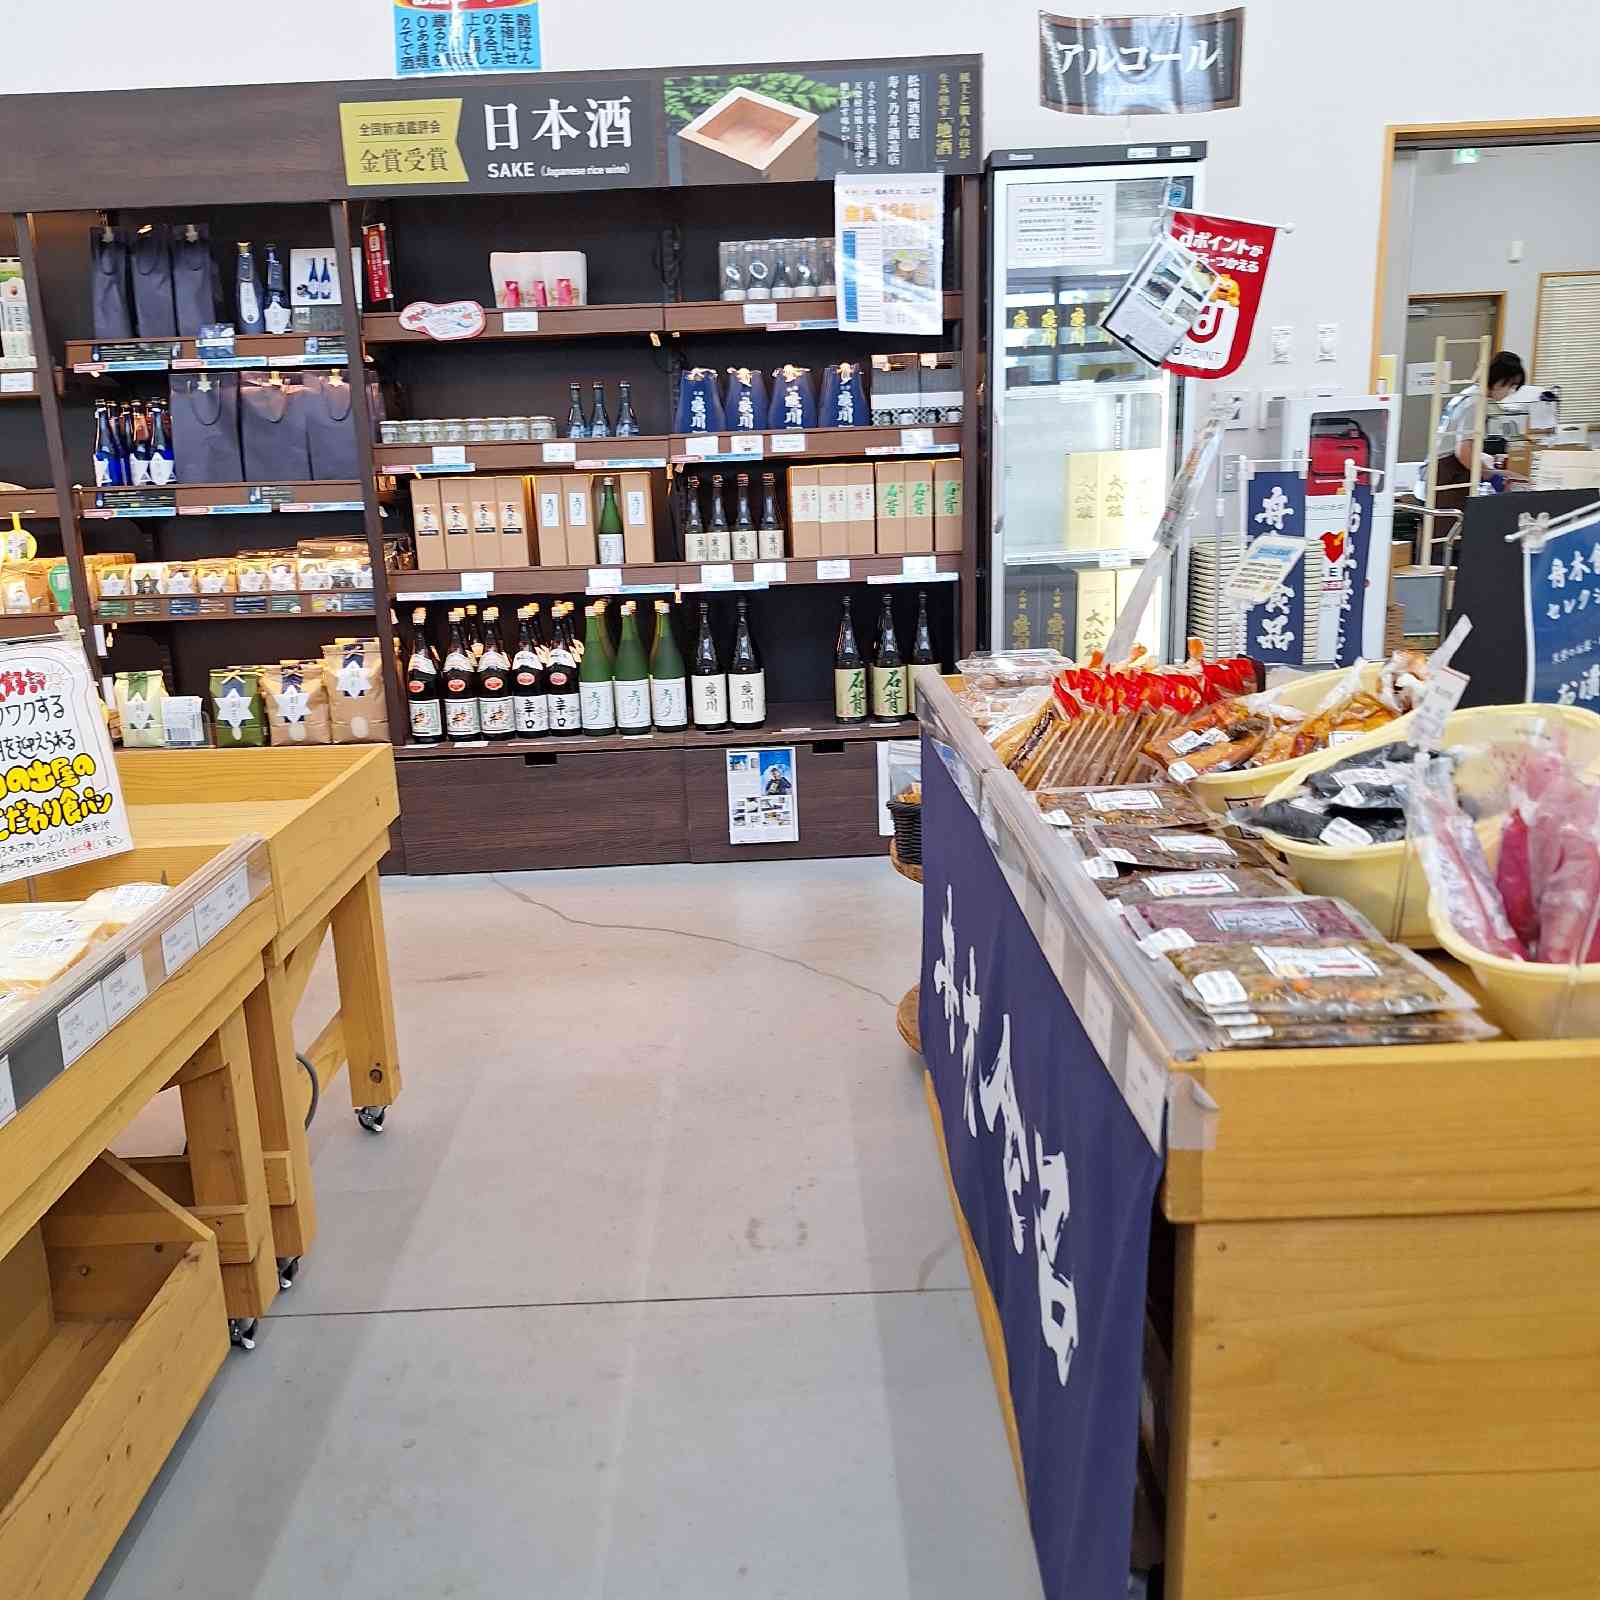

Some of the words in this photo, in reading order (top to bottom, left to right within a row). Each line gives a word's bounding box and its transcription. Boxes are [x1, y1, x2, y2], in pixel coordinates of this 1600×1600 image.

[399, 26, 532, 43] であるとを確認
[400, 13, 532, 30] 20歳上の年齢
[399, 38, 532, 56] できな場合には
[1057, 40, 1221, 75] アルコール
[483, 96, 632, 150] 日本酒
[360, 147, 449, 173] 金賞受賞
[487, 162, 536, 178] SAKE
[1178, 229, 1265, 257] dポイントが
[1196, 252, 1260, 273] る・つかえる
[0, 668, 46, 702] 好評
[0, 729, 76, 760] を迎えられる
